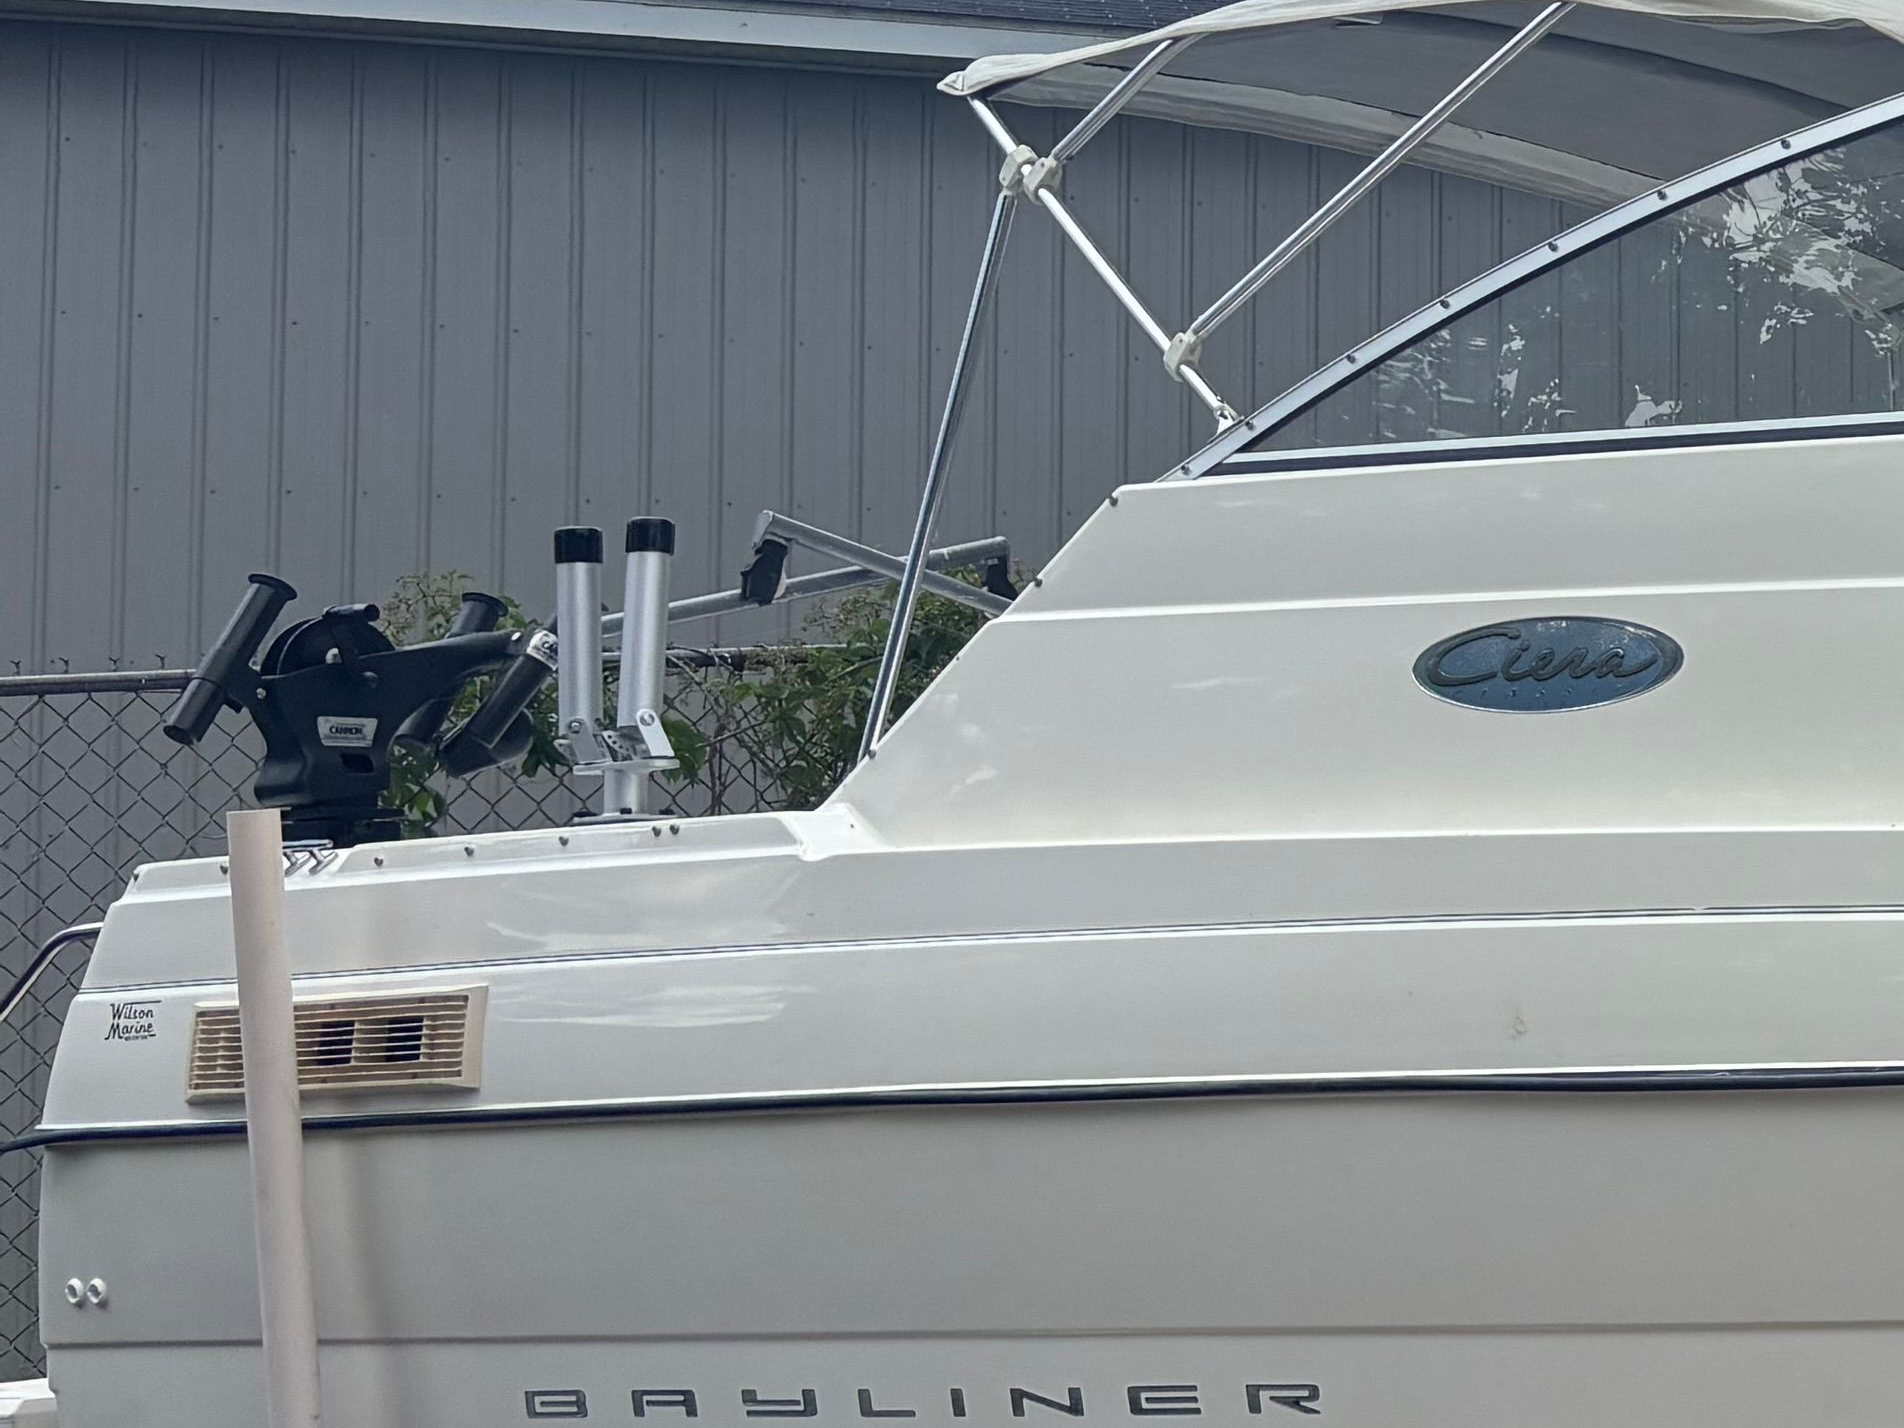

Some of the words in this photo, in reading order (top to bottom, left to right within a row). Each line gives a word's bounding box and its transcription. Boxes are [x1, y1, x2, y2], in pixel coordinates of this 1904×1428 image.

[1427, 627, 1657, 686] Ciera
[110, 1001, 157, 1020] Wilson
[104, 1021, 155, 1040] Marine
[524, 1384, 1322, 1418] BAYLINER
